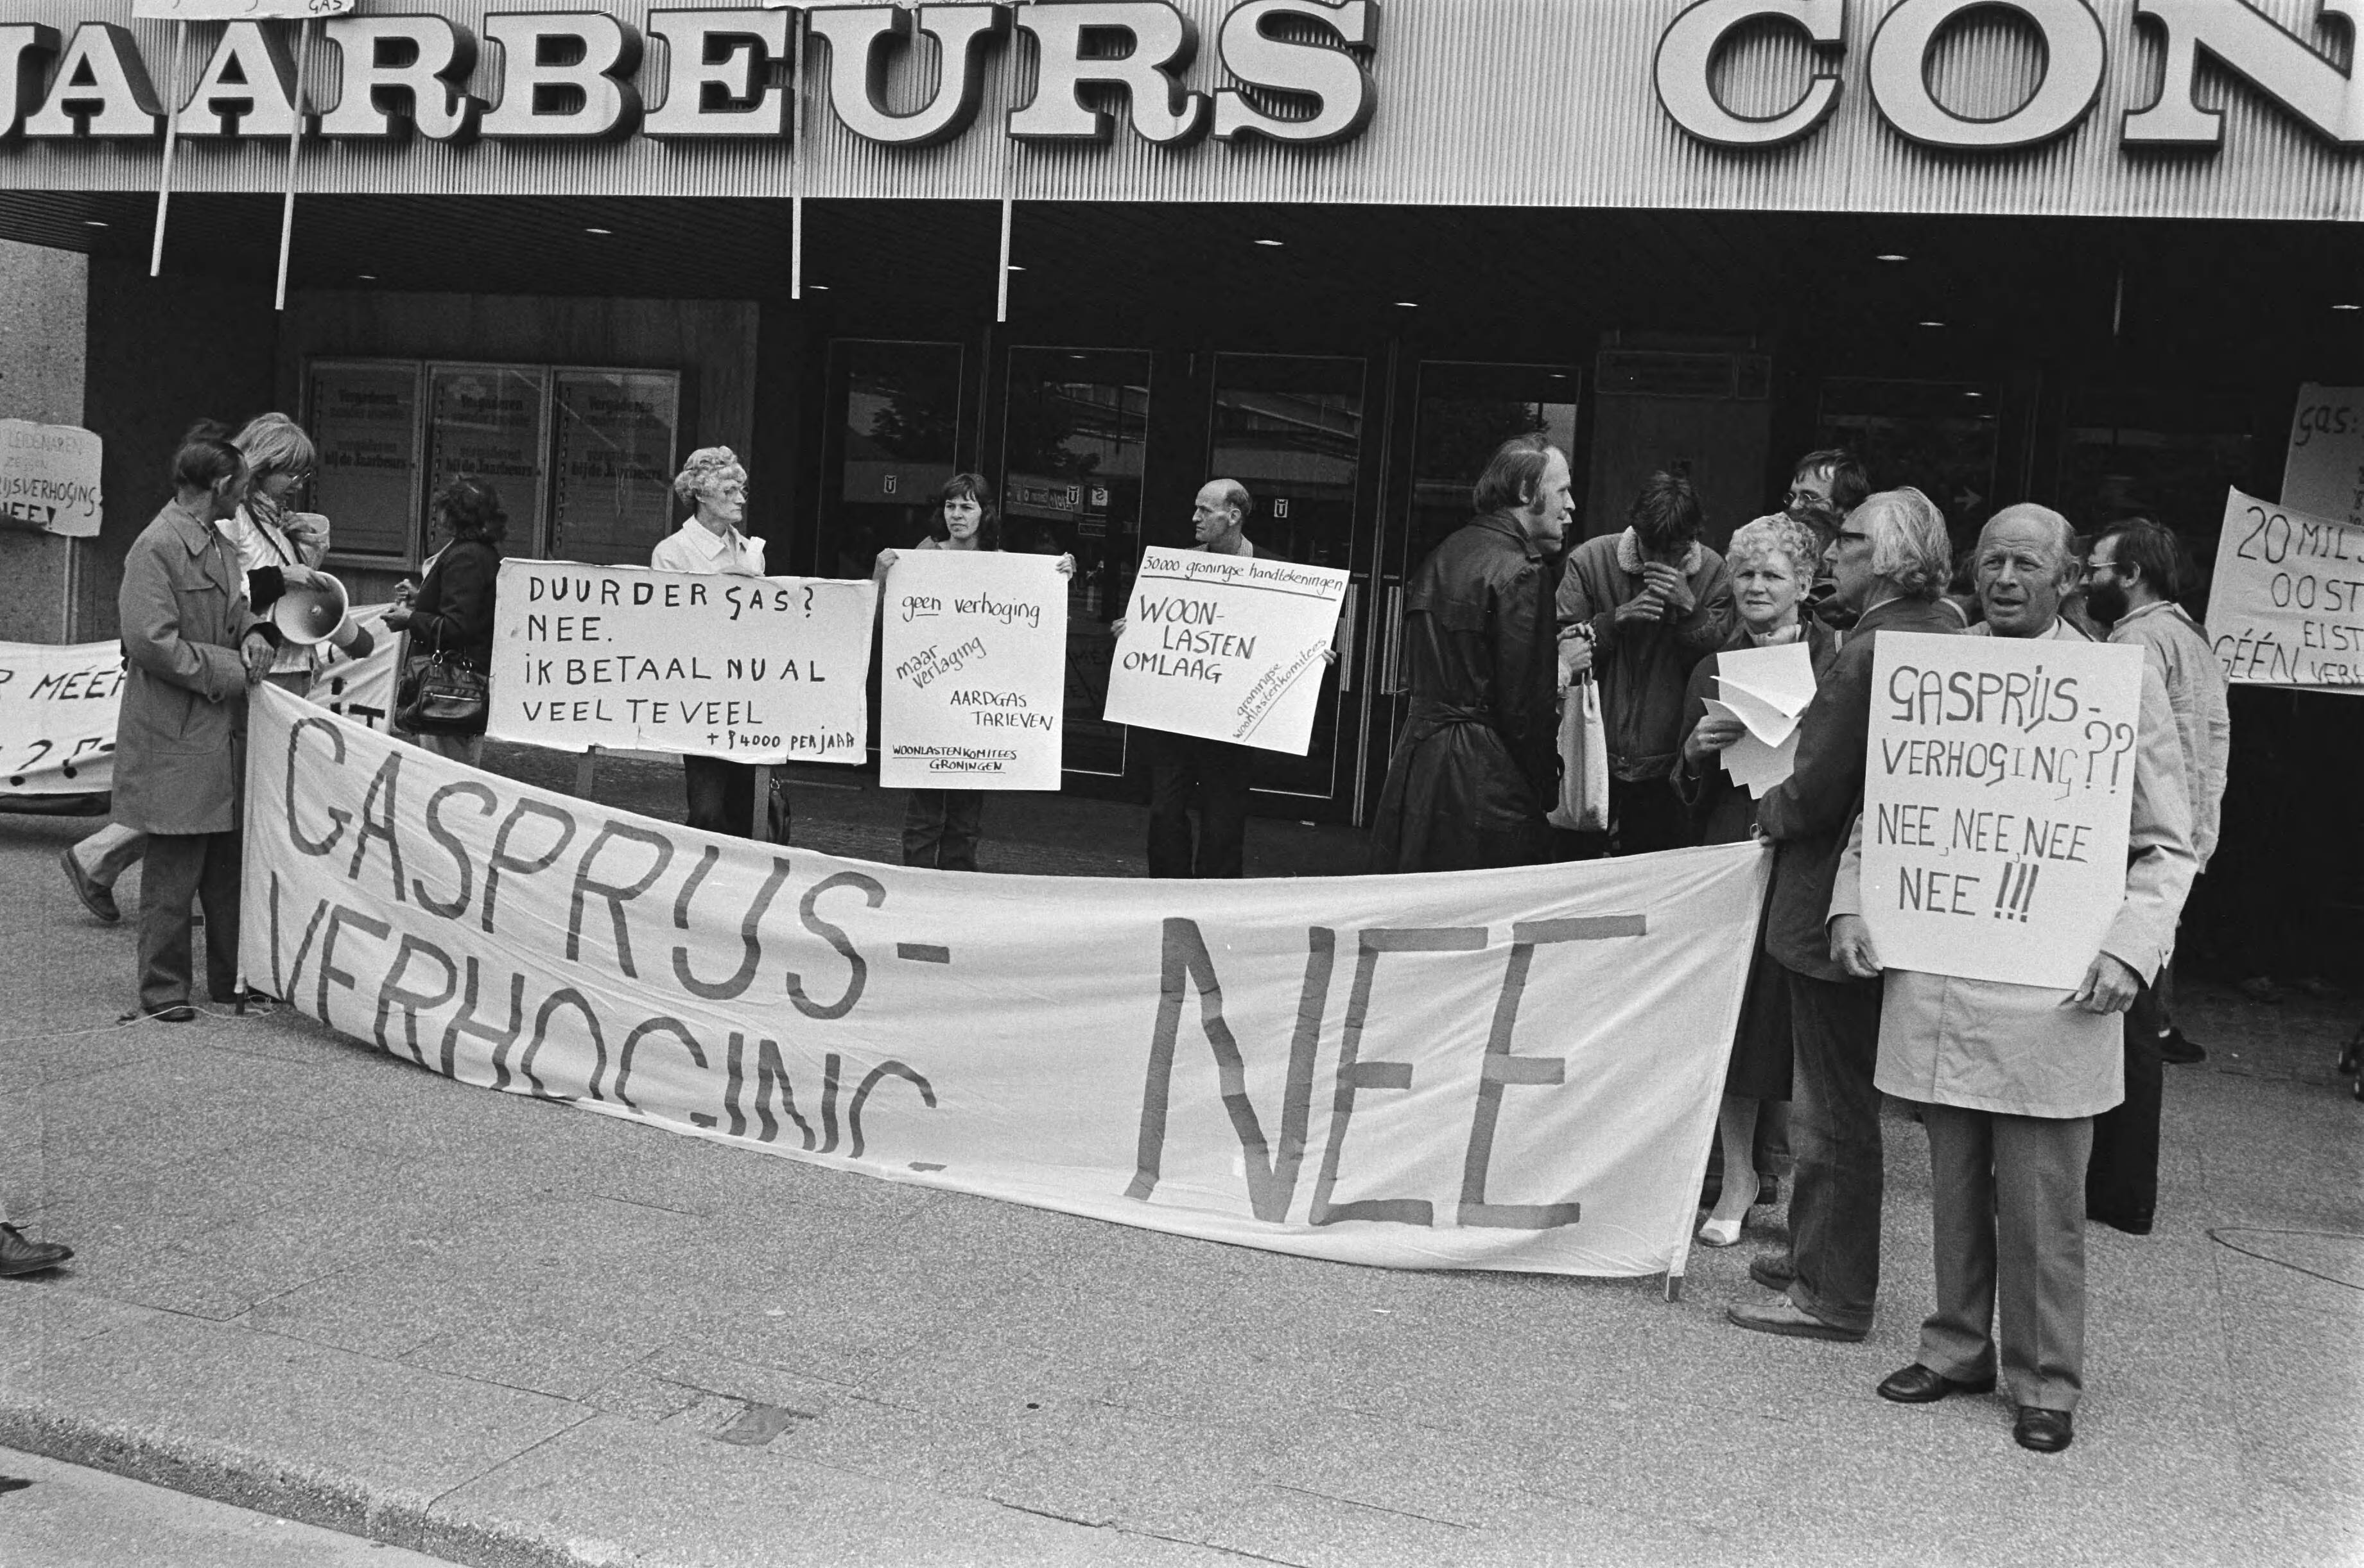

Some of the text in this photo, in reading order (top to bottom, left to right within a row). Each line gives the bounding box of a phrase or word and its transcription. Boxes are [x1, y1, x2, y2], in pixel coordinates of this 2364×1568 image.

[0, 478, 96, 517] IJSVERHOGING
[2238, 506, 2291, 563] 20
[1184, 560, 1244, 583] groningse
[1249, 562, 1344, 596] handtekeningen
[901, 591, 1041, 629] geen verhoging
[1140, 594, 1225, 625] WOON-
[528, 614, 613, 642] NEE.
[1163, 625, 1256, 660] LASTEN
[566, 656, 711, 685] BETAAL
[727, 658, 766, 681] NU
[779, 659, 826, 683] AL
[895, 644, 939, 680] maar
[912, 636, 987, 689] verlaging
[1123, 651, 1222, 684] OMLAAG
[522, 699, 763, 724] VEEL TE VEEL
[950, 690, 1027, 707] AARDGAS
[971, 711, 1054, 731] TARIEVEN
[929, 758, 1003, 772] GRONINGEN
[1124, 914, 1647, 1228] NEE
